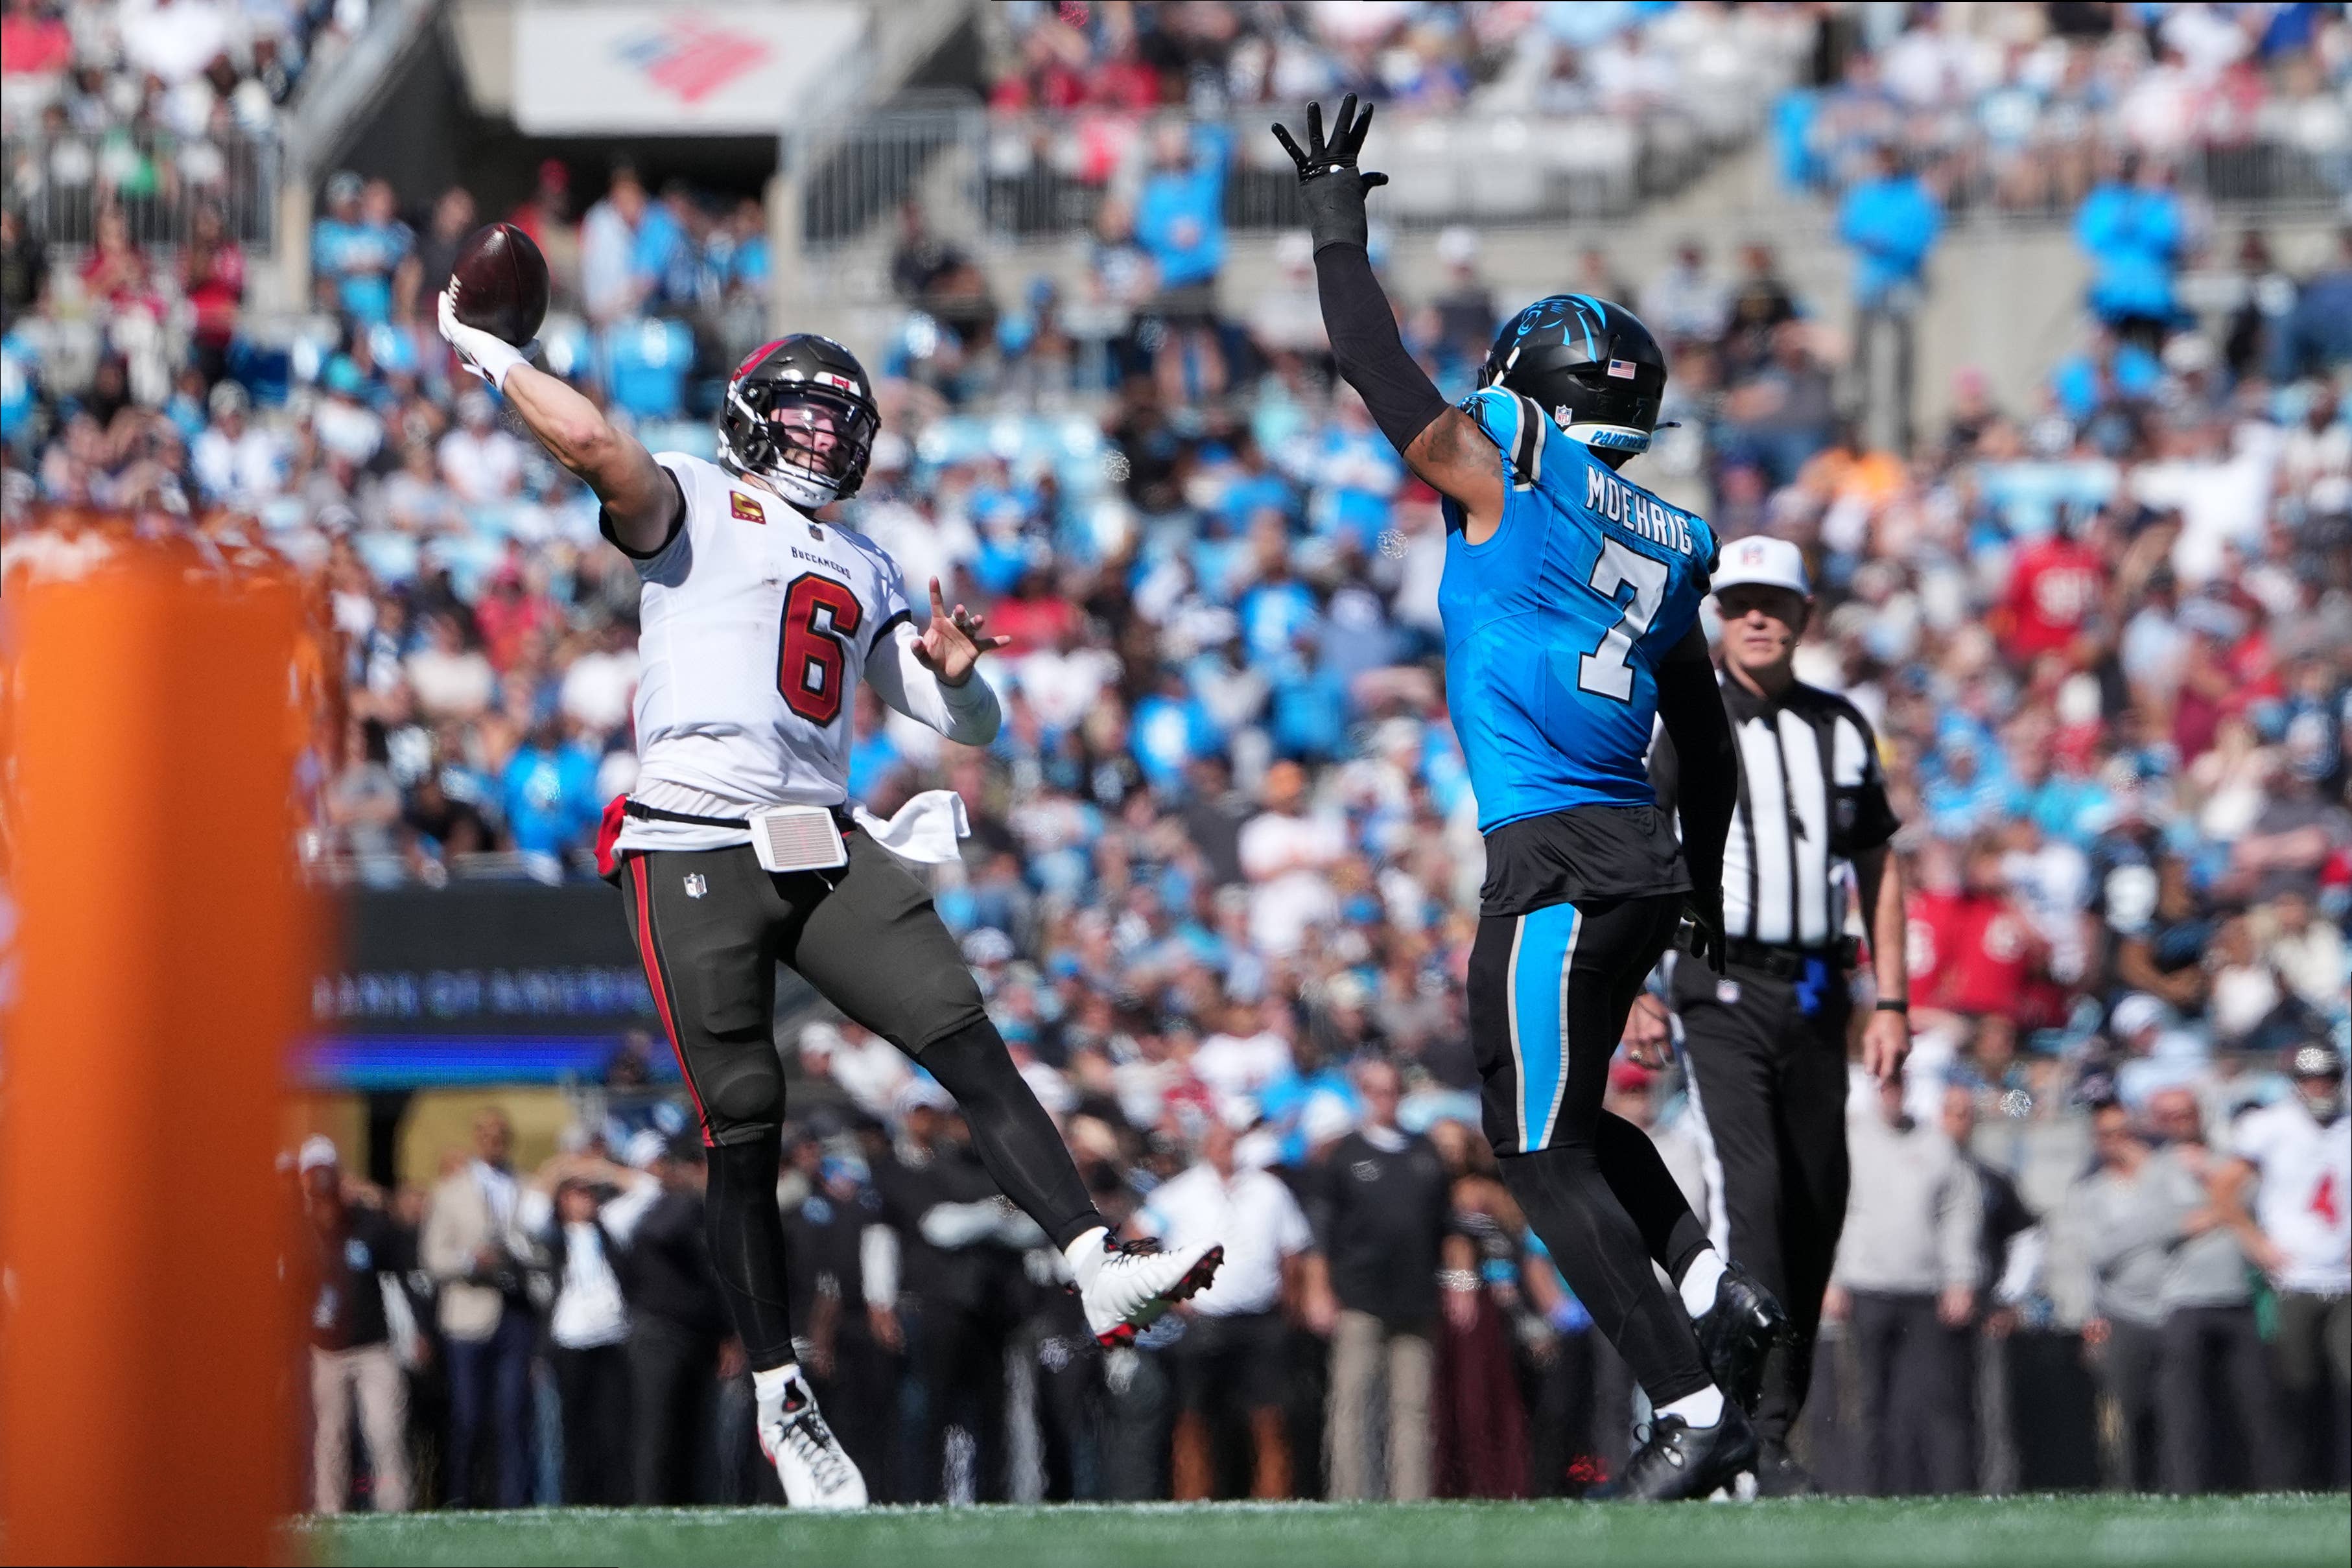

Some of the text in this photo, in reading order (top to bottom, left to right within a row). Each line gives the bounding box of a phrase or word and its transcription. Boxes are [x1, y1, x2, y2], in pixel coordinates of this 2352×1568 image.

[1557, 413, 1569, 424] NFL
[1590, 429, 1649, 450] PANTHERS
[732, 491, 762, 517] C
[1585, 463, 1693, 557] MOEHRIG
[790, 546, 852, 580] BUCCANEERS
[1577, 532, 1671, 705] 7
[777, 571, 863, 727] 6
